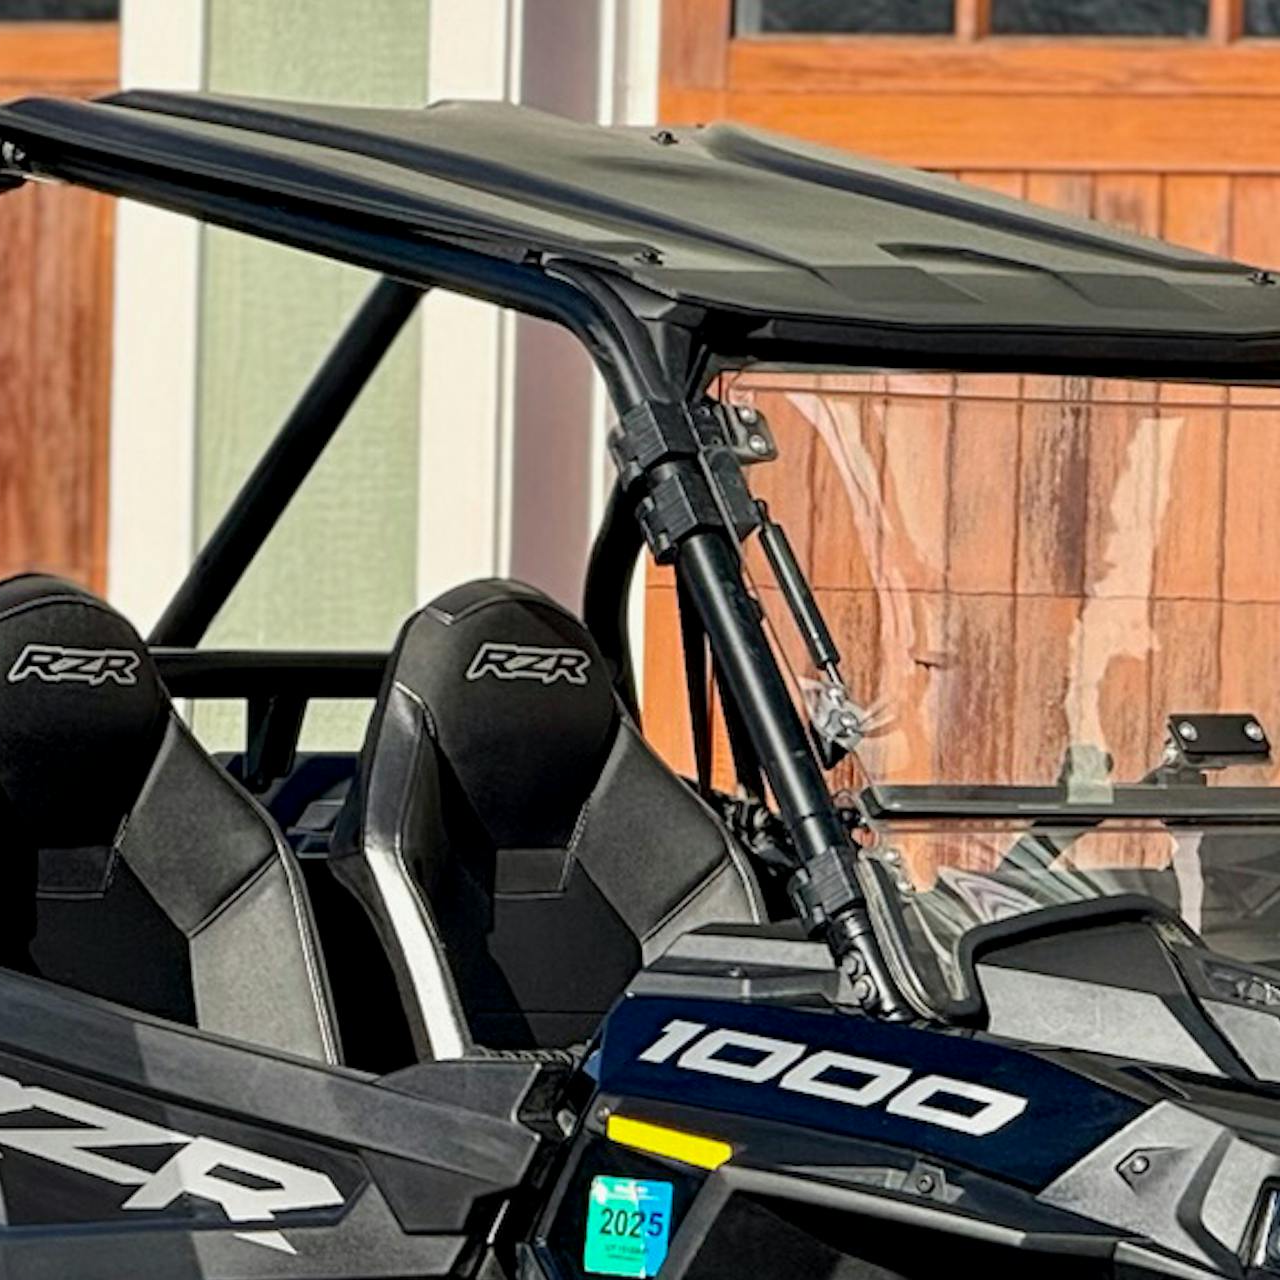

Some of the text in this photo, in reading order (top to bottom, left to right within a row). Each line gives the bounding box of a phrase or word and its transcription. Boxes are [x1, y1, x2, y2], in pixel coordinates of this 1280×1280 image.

[8, 643, 140, 686] RZR
[466, 643, 591, 685] RZR
[639, 1019, 1028, 1137] 1000
[600, 1207, 663, 1238] 2025
